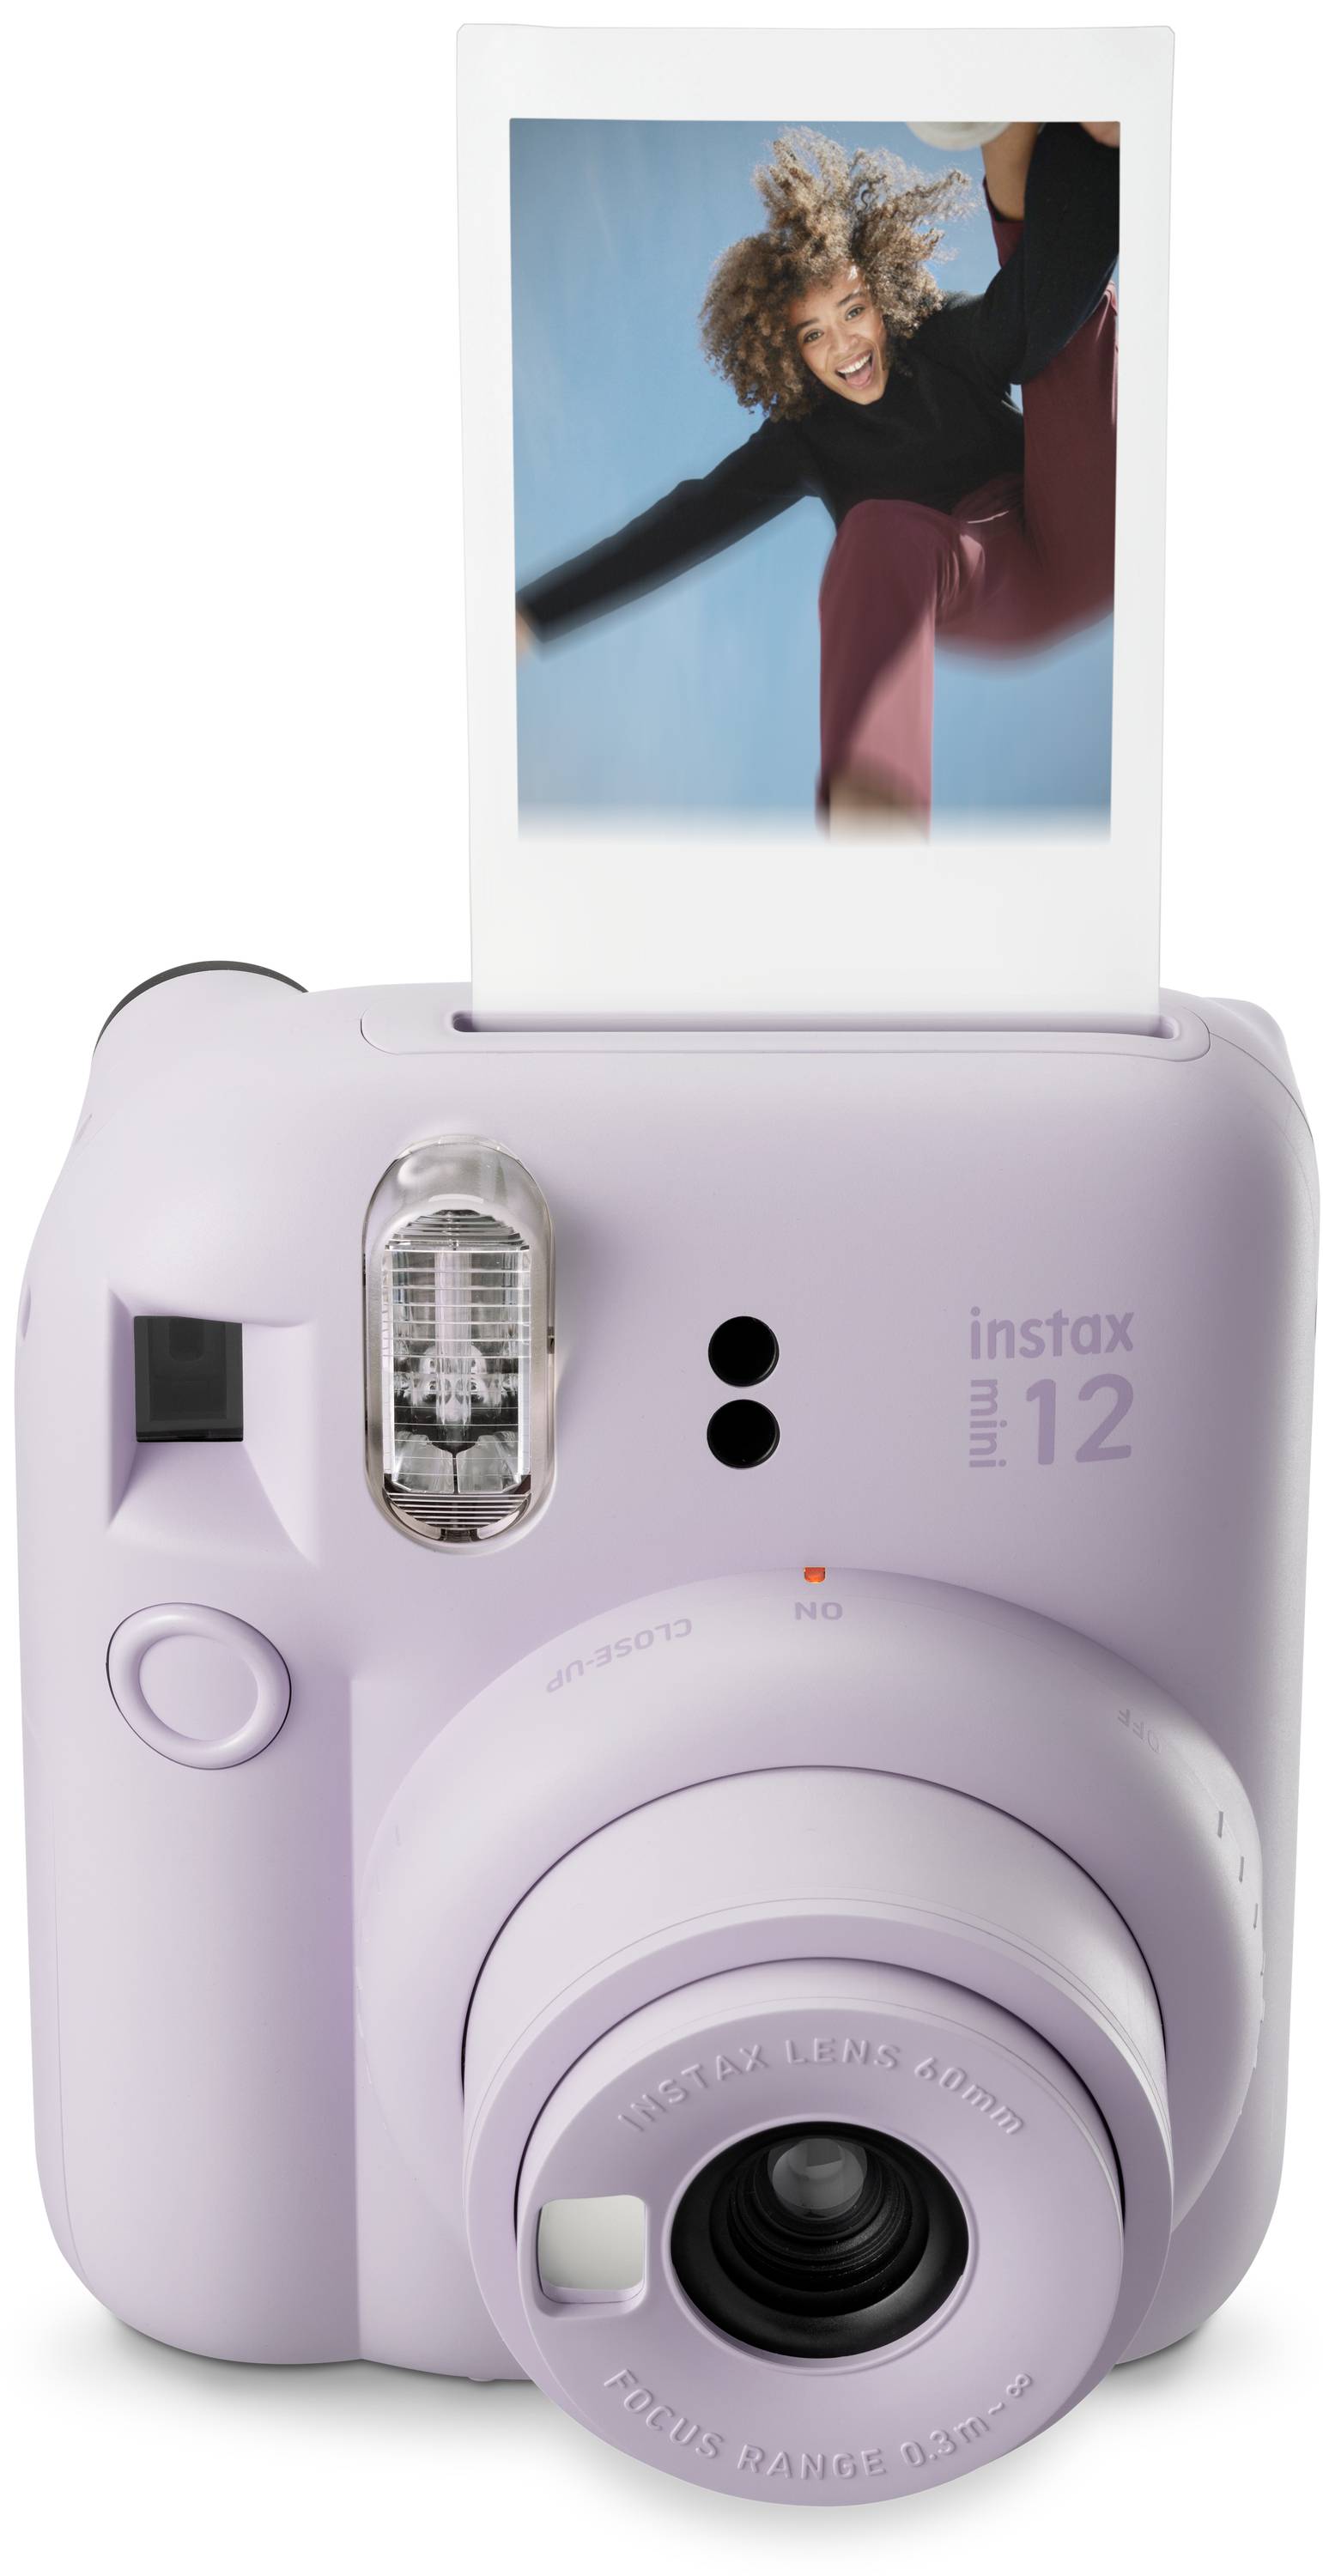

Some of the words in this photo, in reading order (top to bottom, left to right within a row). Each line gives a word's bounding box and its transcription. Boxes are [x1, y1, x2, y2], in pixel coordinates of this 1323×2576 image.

[970, 1306, 1134, 1359] instax
[969, 1379, 1007, 1467] mini
[1025, 1374, 1133, 1465] 12
[794, 1601, 843, 1620] ON
[545, 1618, 693, 1693] CLOSE-UP
[617, 2044, 770, 2132] INSTAX
[784, 2037, 901, 2069] LENS
[913, 2057, 1026, 2136] 60mm
[604, 2368, 726, 2460] FOCUS
[737, 2444, 887, 2480] RANGE
